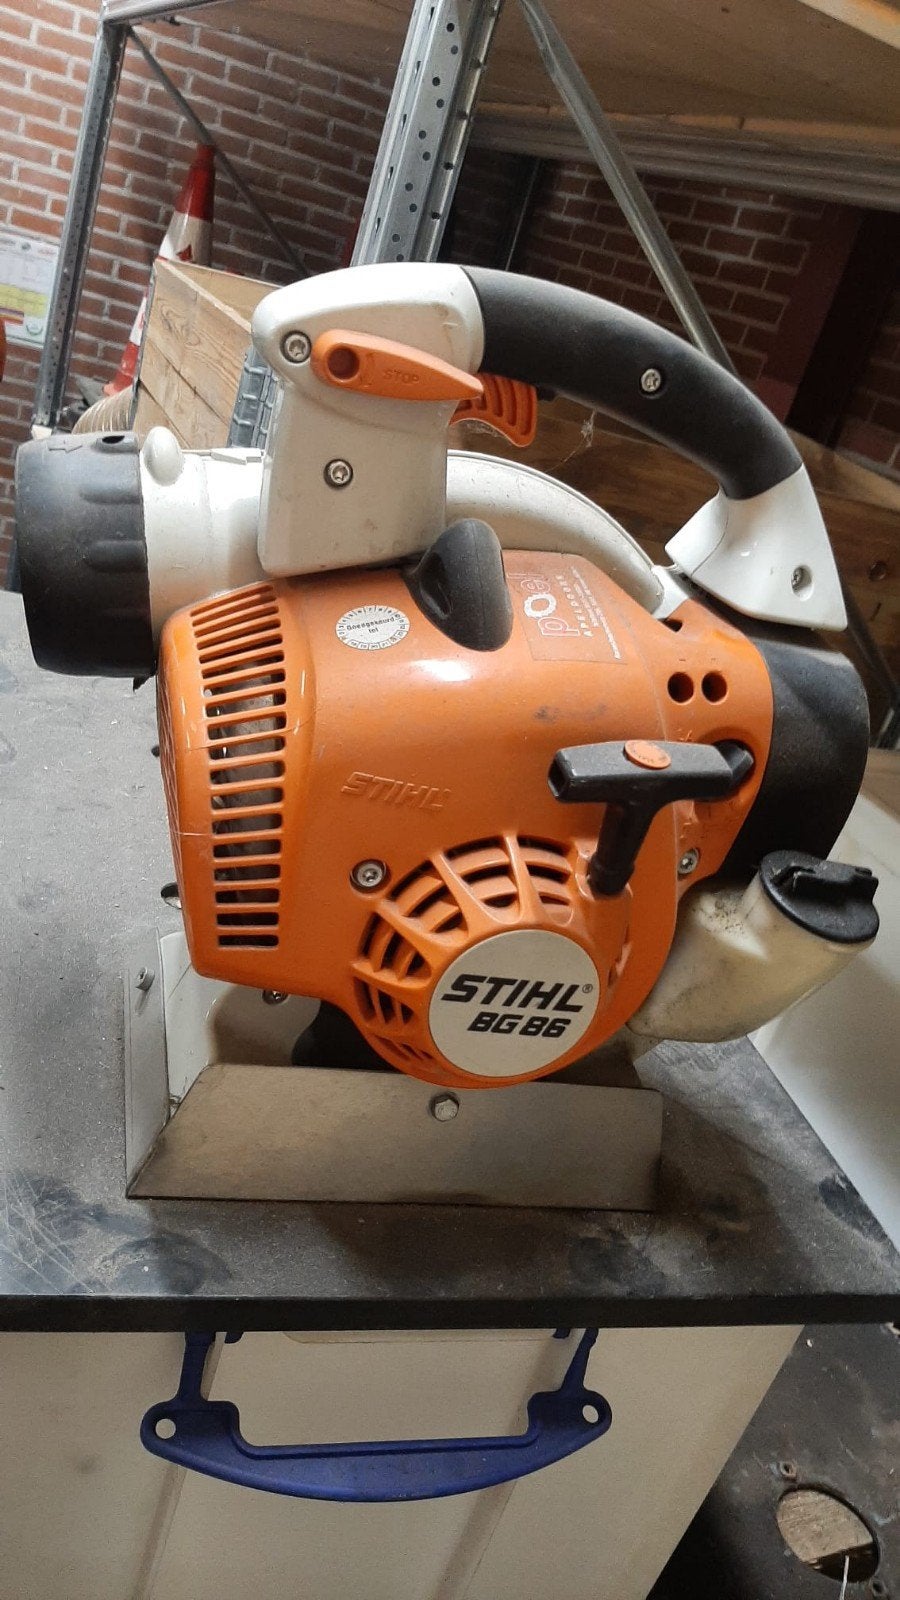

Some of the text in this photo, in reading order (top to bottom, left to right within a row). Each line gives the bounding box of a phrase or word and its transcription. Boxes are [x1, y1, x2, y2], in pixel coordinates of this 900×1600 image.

[384, 368, 420, 384] STOP
[346, 616, 395, 631] Goedgekeurd
[340, 771, 444, 811] STIHL
[467, 1011, 572, 1038] BG 86
